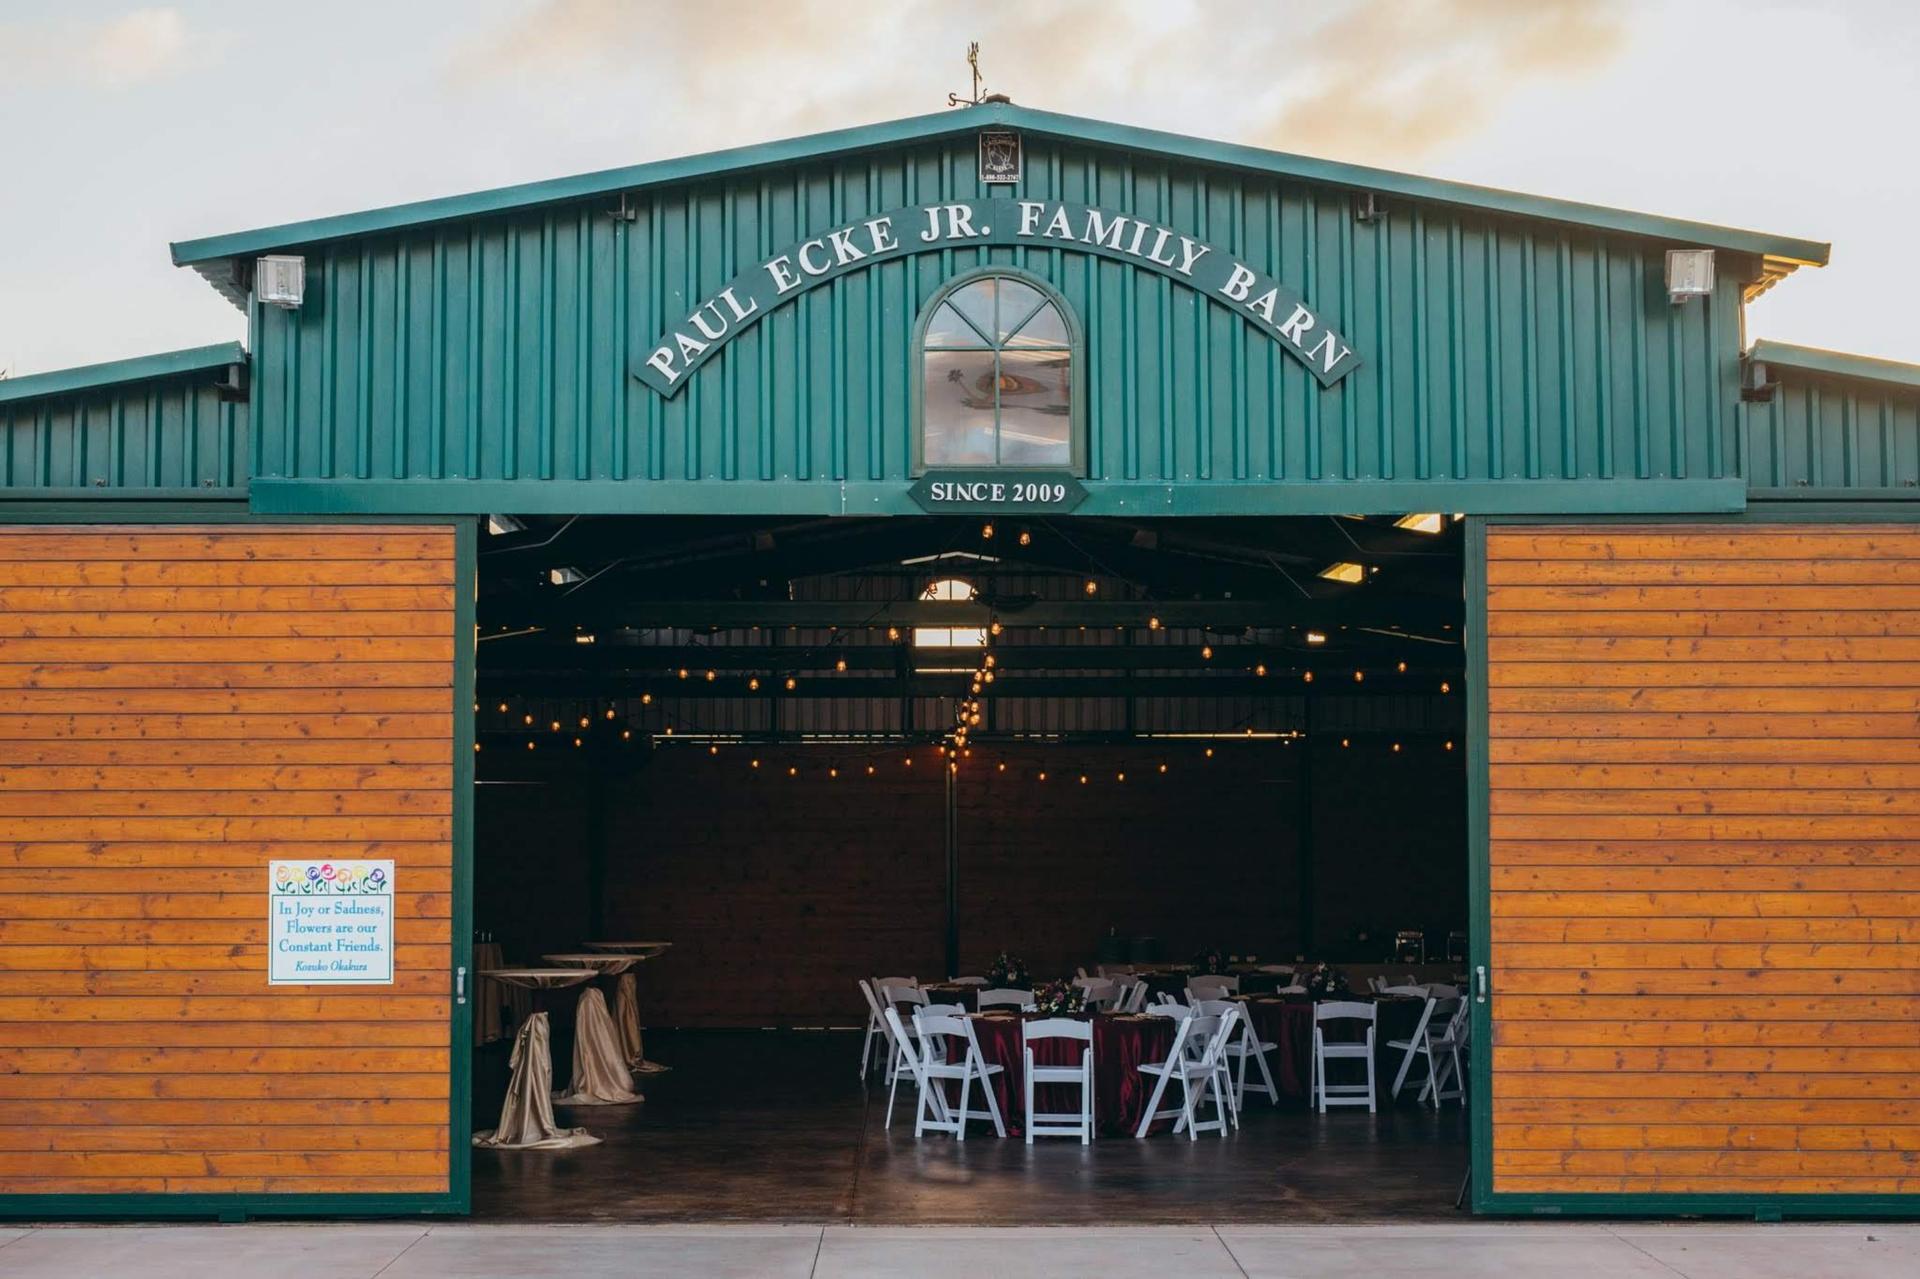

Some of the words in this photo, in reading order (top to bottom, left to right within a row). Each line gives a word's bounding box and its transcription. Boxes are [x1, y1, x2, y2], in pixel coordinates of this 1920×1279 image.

[646, 287, 758, 385] PAUL
[763, 216, 898, 295] ECKE
[920, 203, 991, 243] JR.
[1017, 201, 1211, 276] FAMILY
[1218, 262, 1351, 374] BARN
[931, 482, 1005, 501] SINCE
[1012, 483, 1065, 502] 2009
[279, 901, 292, 915] In
[295, 901, 314, 917] Joy
[318, 905, 331, 915] or
[334, 900, 384, 917] Sadness,
[287, 919, 332, 933] Flowers
[335, 924, 353, 933] are
[357, 924, 377, 933] our
[279, 939, 333, 952] Constant
[336, 937, 383, 952] Friends.
[330, 960, 368, 972] Okakura
